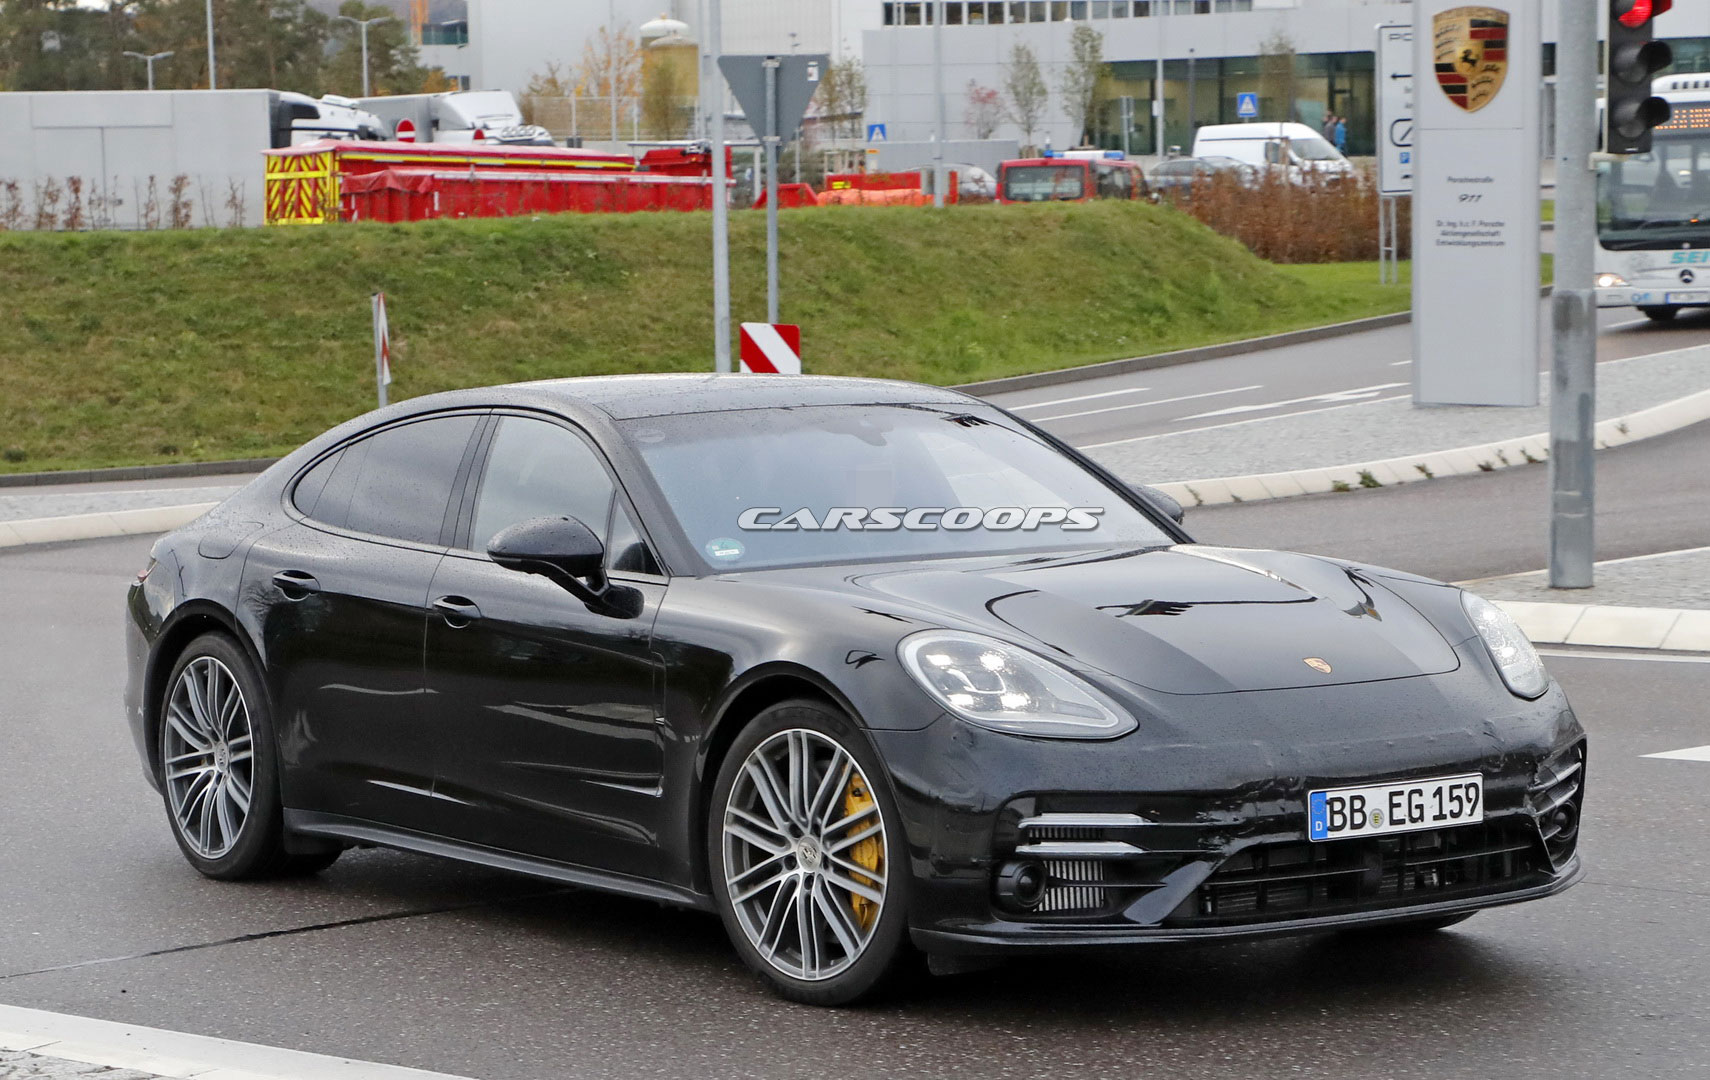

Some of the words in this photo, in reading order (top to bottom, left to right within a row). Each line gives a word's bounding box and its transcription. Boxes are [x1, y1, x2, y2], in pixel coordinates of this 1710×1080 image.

[1458, 193, 1483, 202] 911
[1315, 820, 1323, 831] D
[1326, 795, 1368, 832] BB
[1388, 789, 1425, 827] EG
[1432, 782, 1481, 822] 159
